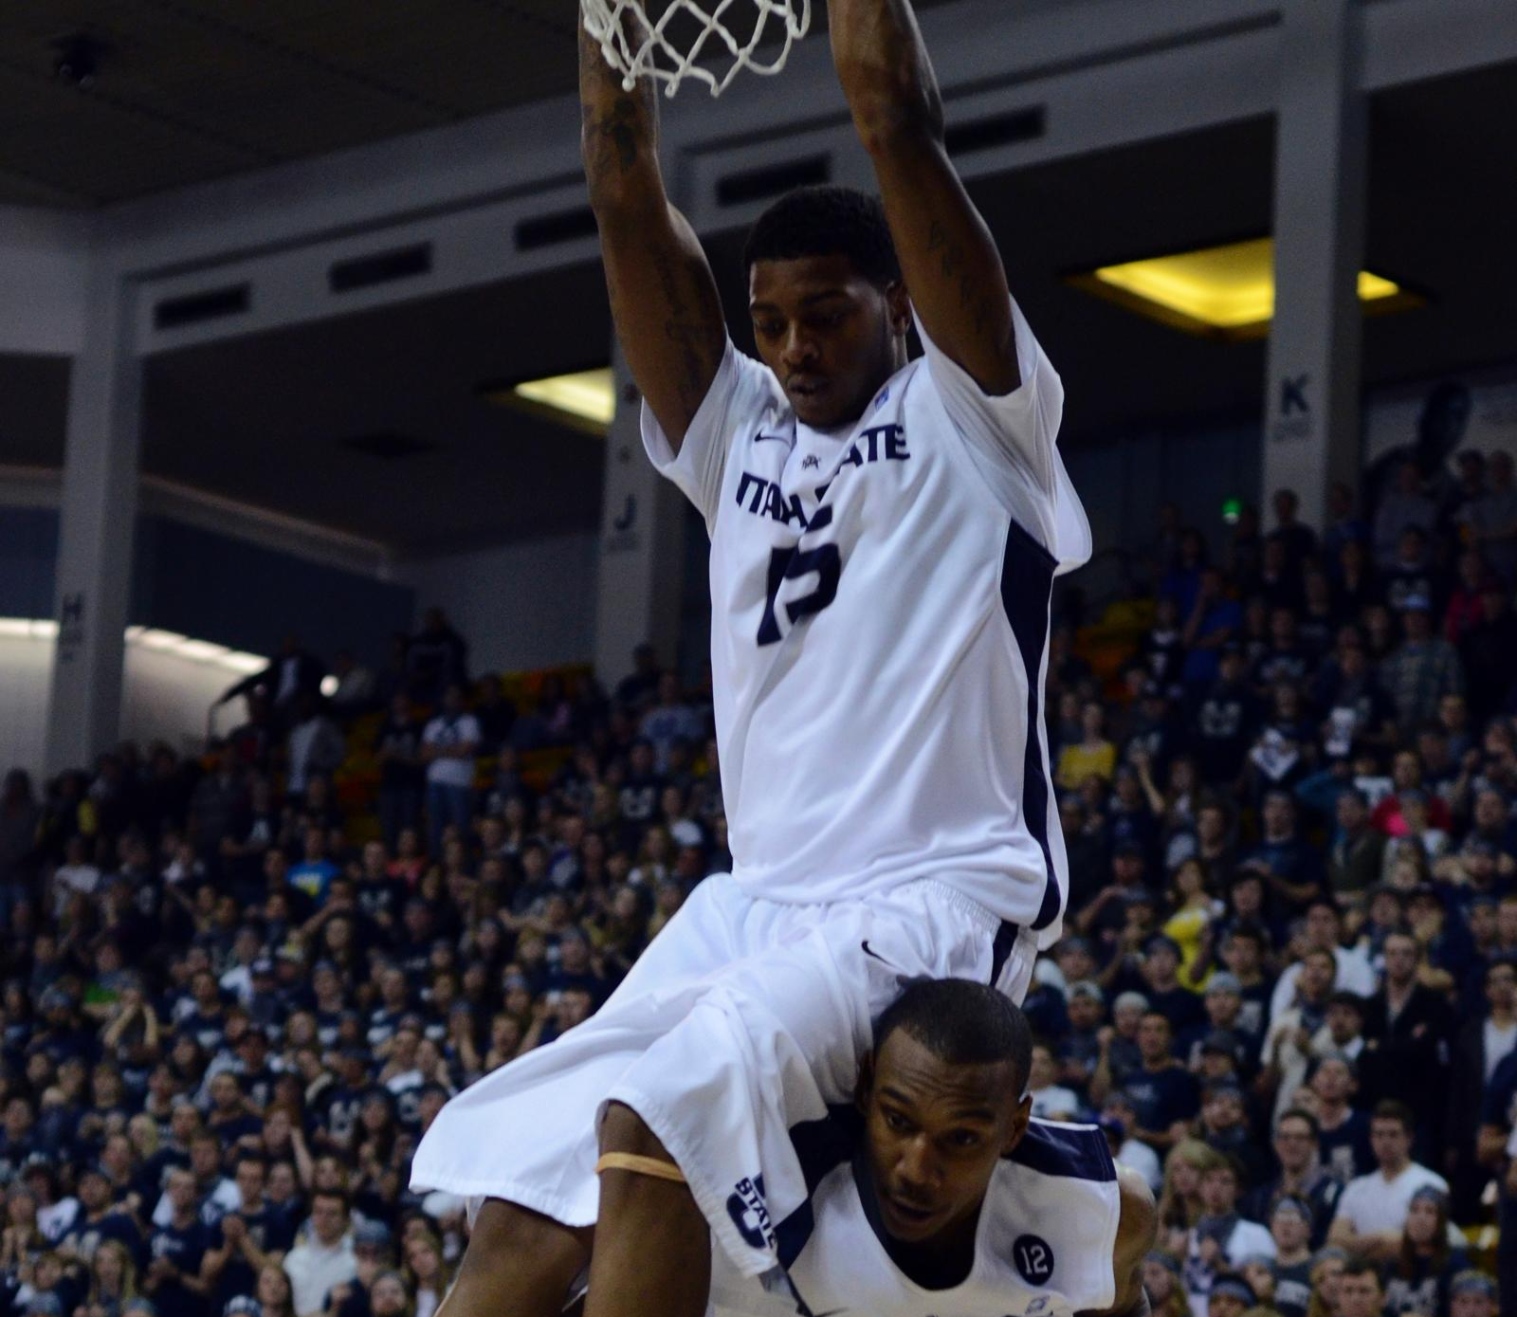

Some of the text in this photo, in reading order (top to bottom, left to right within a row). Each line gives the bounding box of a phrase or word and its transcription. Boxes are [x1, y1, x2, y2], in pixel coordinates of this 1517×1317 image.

[1280, 374, 1310, 415] K
[614, 493, 637, 530] J
[1020, 1244, 1049, 1275] 12
